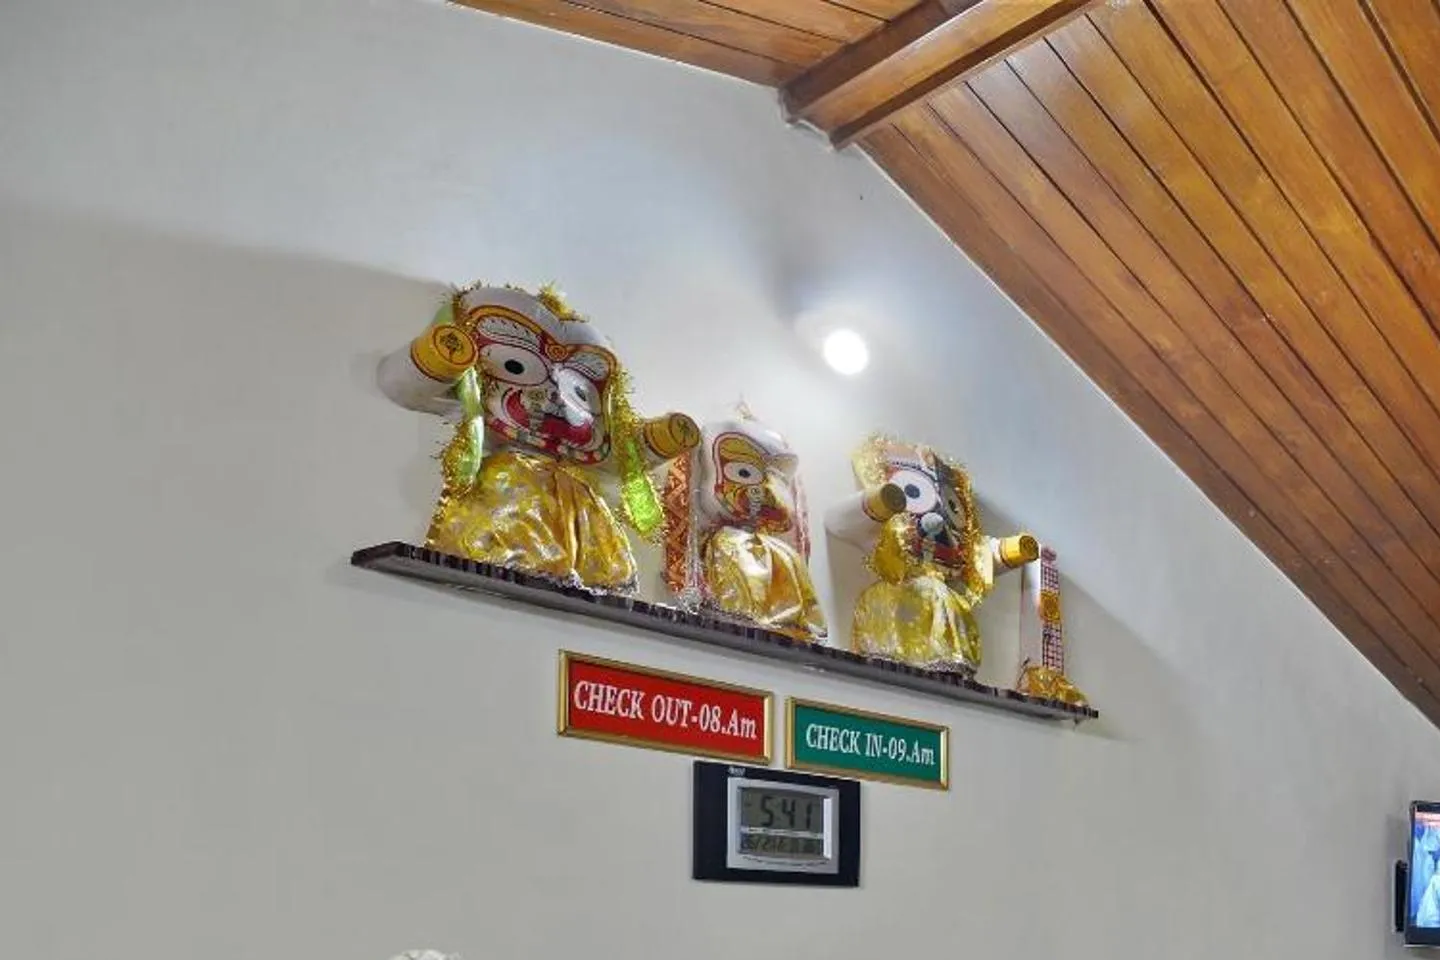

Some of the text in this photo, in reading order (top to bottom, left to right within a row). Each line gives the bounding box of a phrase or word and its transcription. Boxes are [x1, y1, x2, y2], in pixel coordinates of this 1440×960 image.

[574, 680, 757, 740] CHECK OUT-08.Am
[806, 723, 935, 765] CHECK IN-09.Am
